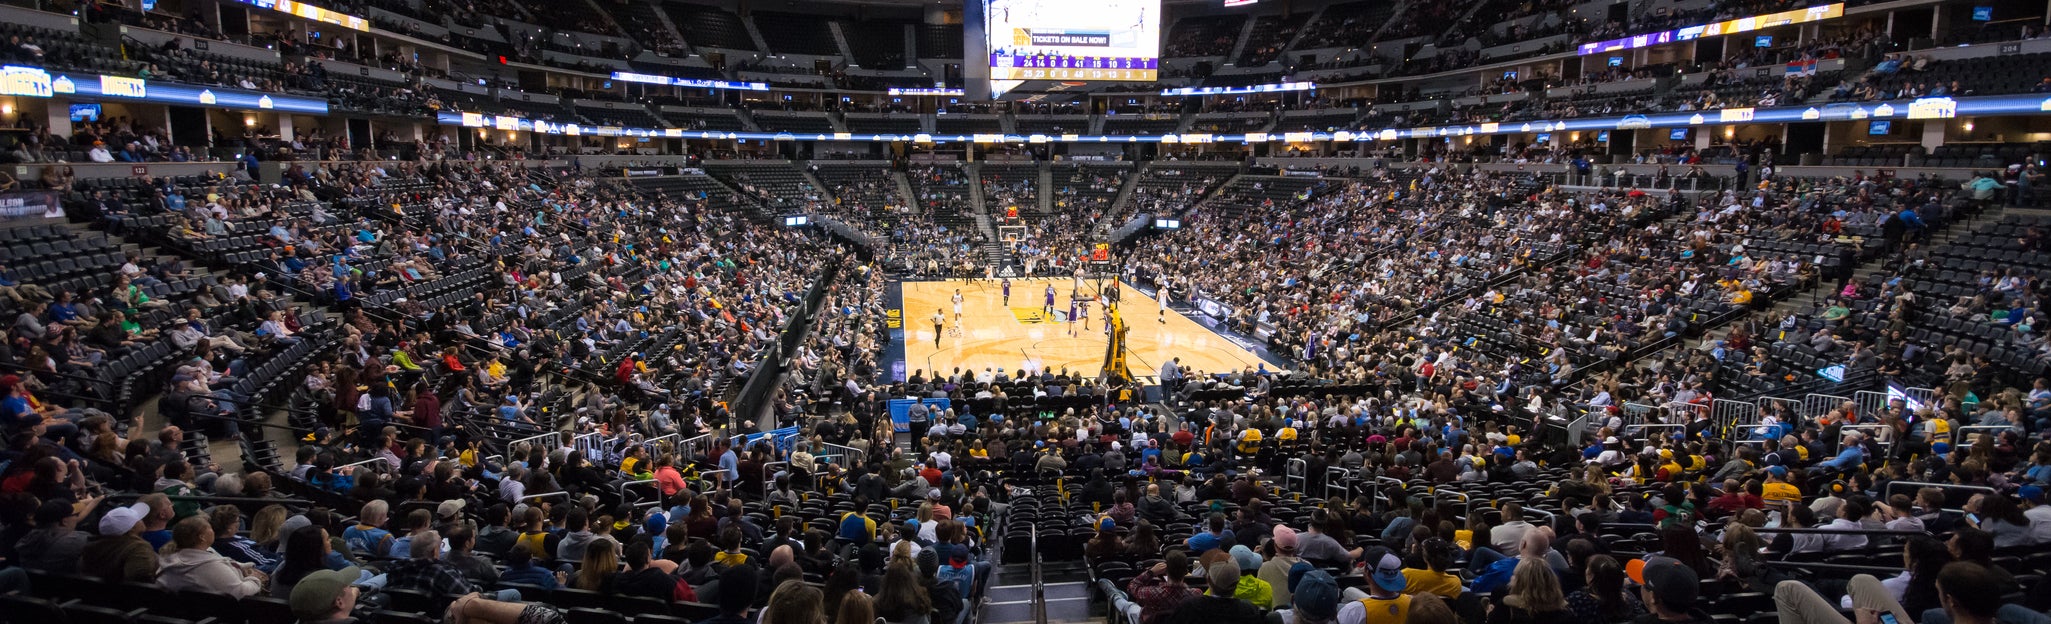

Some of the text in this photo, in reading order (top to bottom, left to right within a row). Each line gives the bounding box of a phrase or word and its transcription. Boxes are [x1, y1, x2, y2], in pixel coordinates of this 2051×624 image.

[1033, 35, 1060, 43] TICKETS
[1061, 36, 1071, 44] ON
[1071, 36, 1088, 44] SALE
[1658, 31, 1671, 43] 41
[1023, 59, 1033, 67] 24
[1075, 60, 1084, 68] 41
